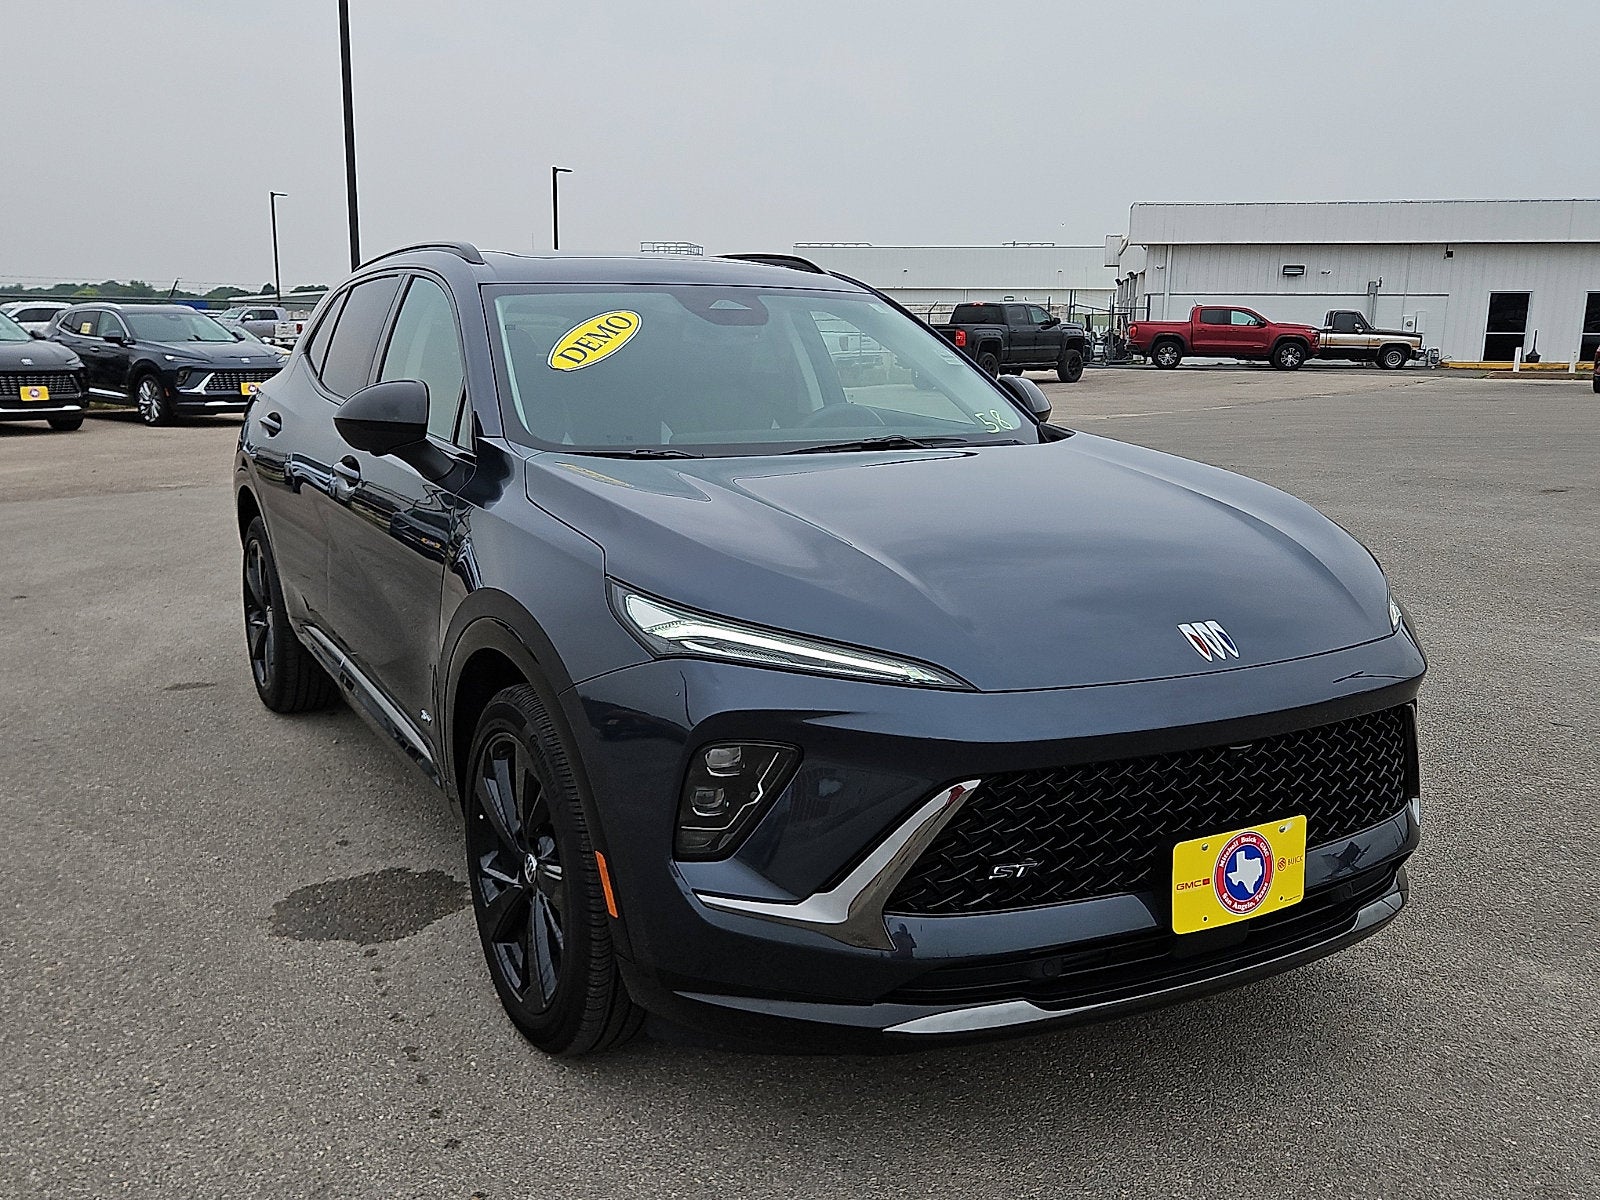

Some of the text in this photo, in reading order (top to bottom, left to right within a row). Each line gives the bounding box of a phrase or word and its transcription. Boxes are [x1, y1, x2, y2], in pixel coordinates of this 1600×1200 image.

[557, 316, 632, 364] DEMO
[974, 409, 1013, 434] 58
[1219, 836, 1270, 868] Mitchell Buick GMC
[1287, 855, 1303, 866] BUICK
[988, 862, 1038, 880] ST
[1176, 879, 1202, 891] GMC
[1221, 892, 1233, 906] San
[1254, 881, 1269, 902] Texas
